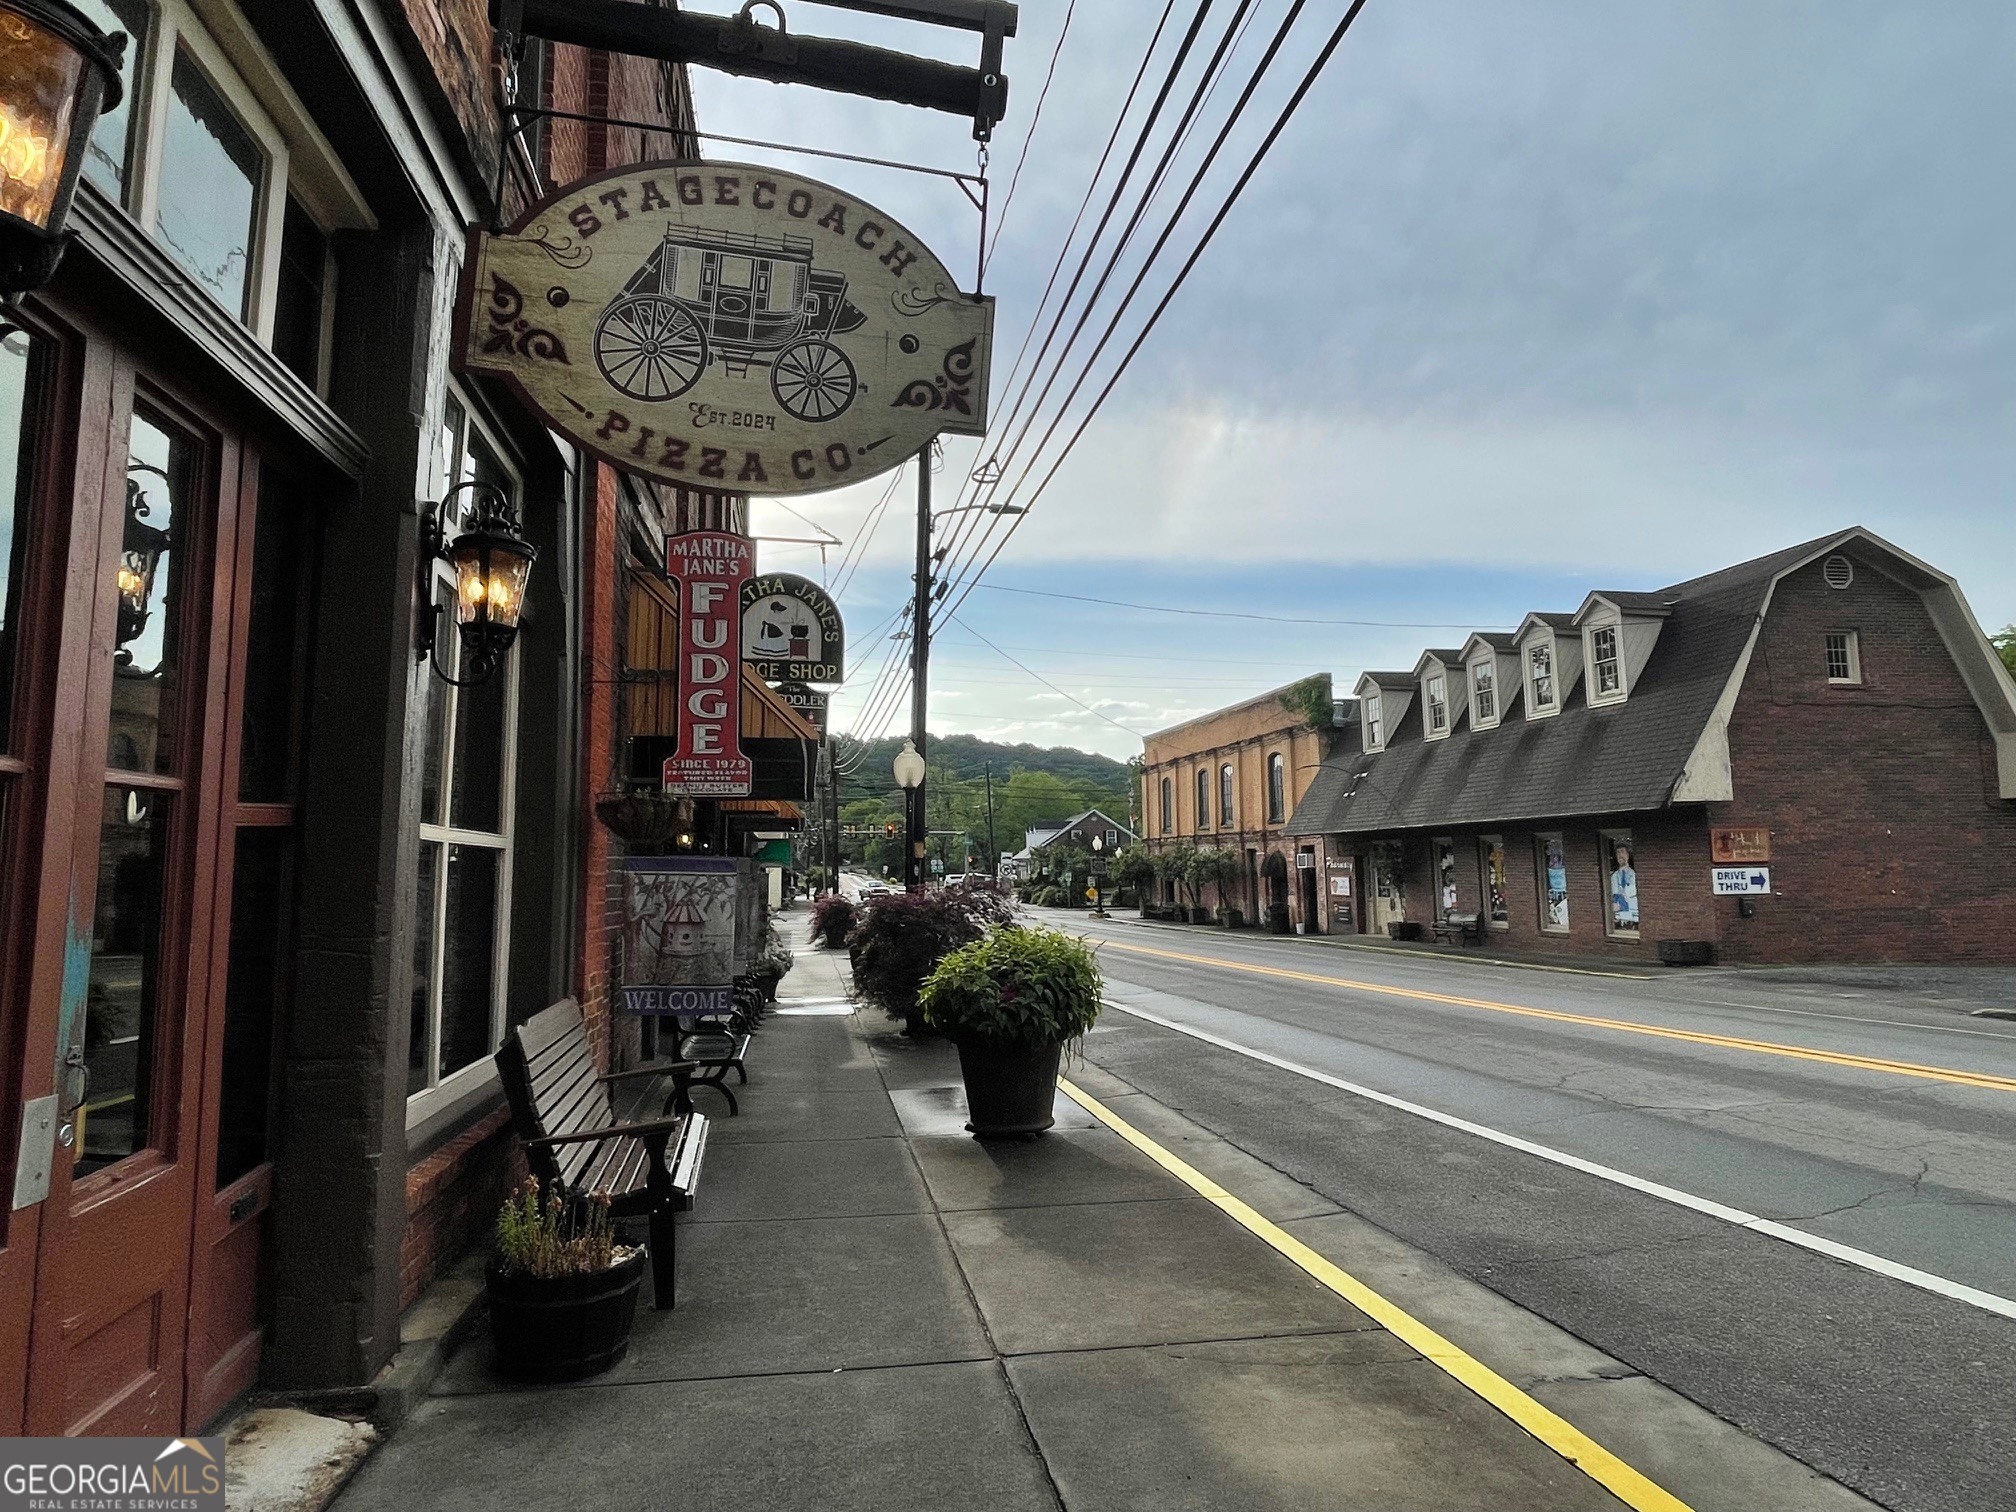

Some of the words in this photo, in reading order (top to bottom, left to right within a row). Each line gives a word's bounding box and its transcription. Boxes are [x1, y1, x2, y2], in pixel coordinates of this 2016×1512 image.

[568, 175, 917, 278] STAGECOACH
[595, 409, 768, 482] PIZZA
[673, 538, 748, 558] MARTHA
[680, 558, 739, 577] JANE'S
[795, 584, 839, 642] JANE'S
[687, 581, 730, 755] FUDGE
[789, 664, 837, 680] SHOP
[672, 759, 711, 769] SINCE
[716, 759, 746, 769] 1979
[1717, 871, 1747, 880] DRIVE
[1718, 883, 1748, 891] THRU
[624, 991, 728, 1010] WELCOME
